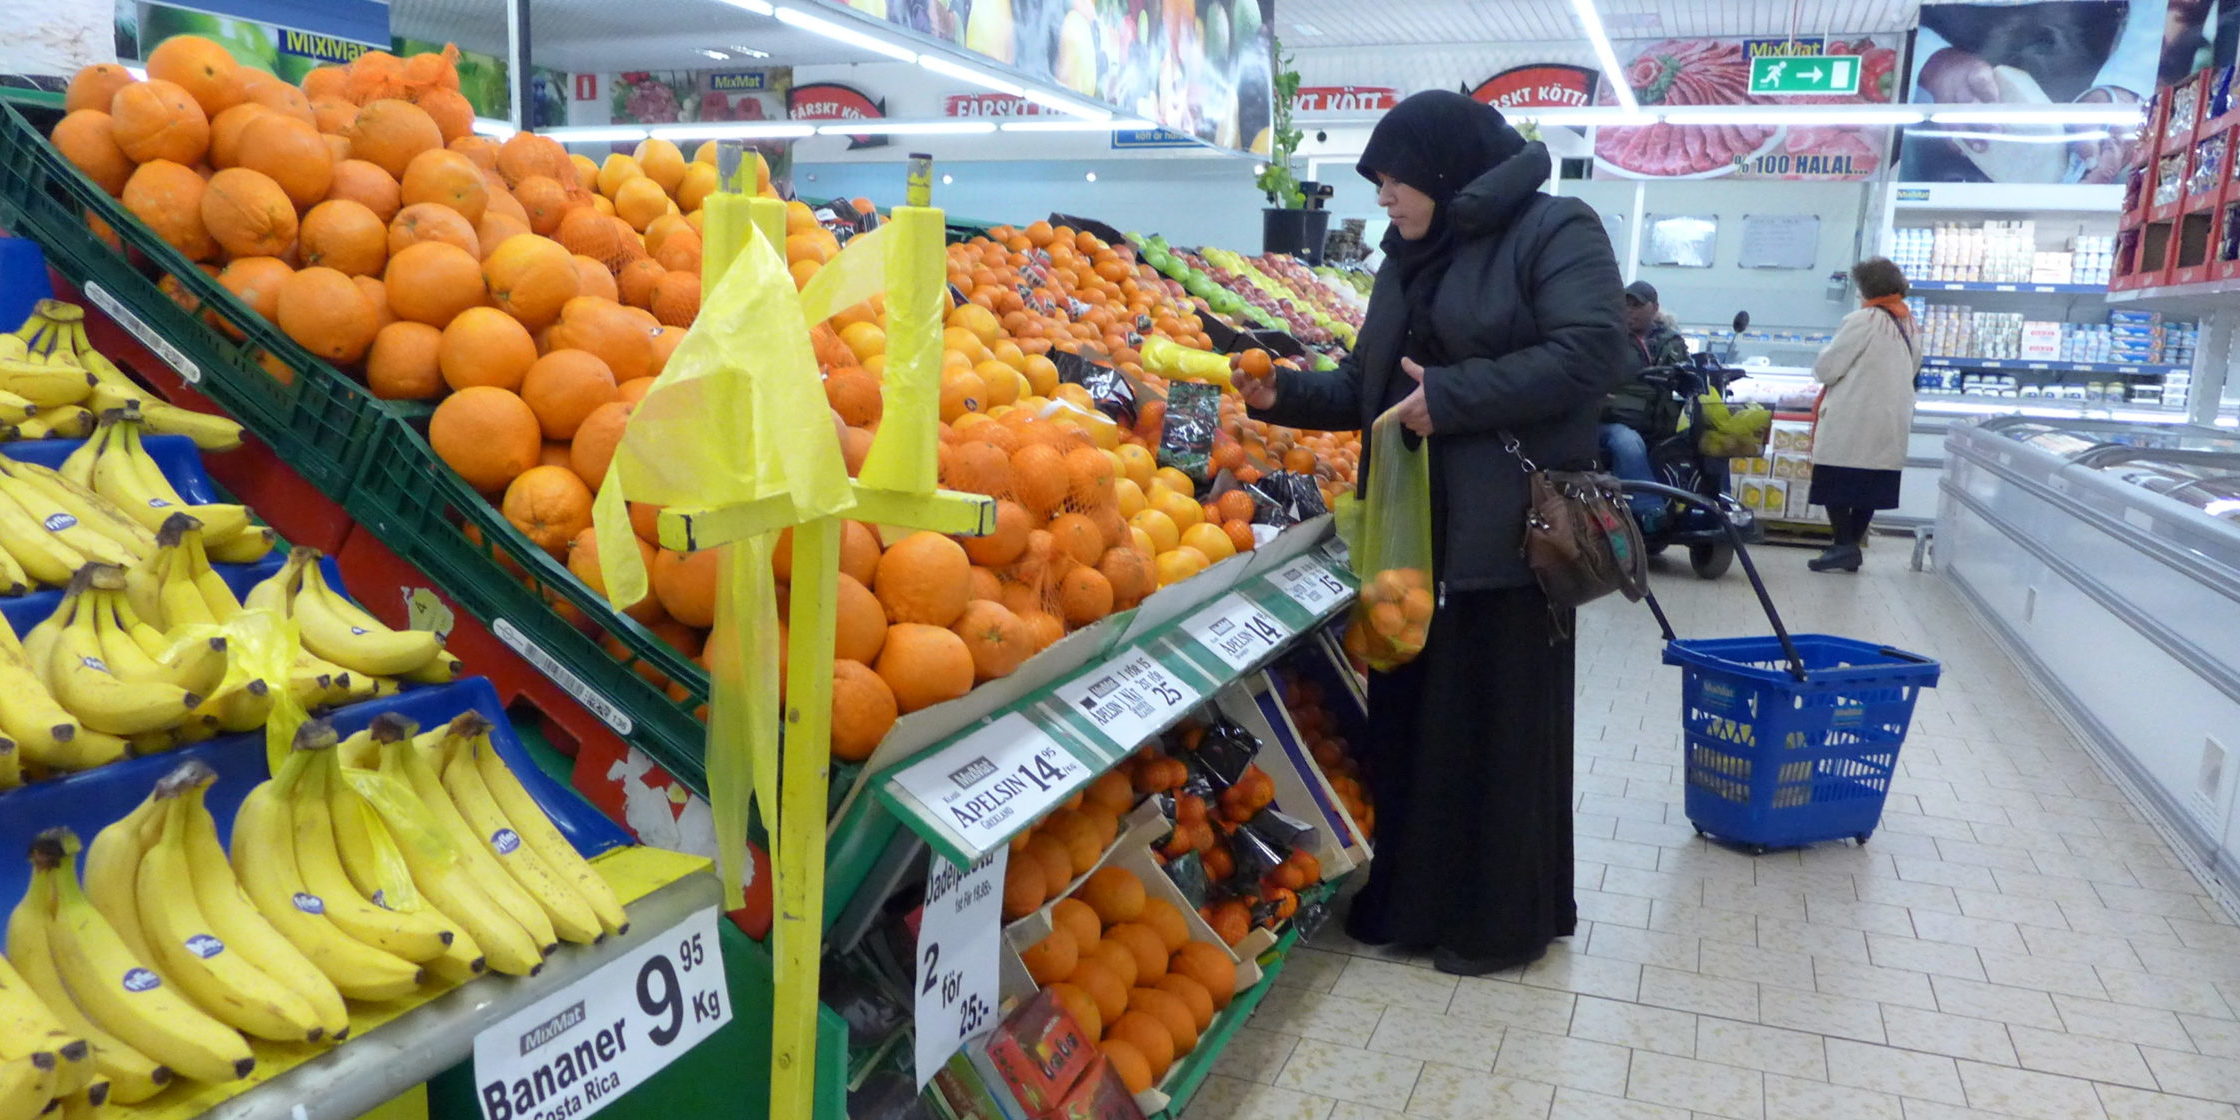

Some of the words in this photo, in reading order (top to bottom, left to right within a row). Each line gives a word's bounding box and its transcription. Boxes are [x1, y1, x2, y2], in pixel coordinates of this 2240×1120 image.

[1750, 41, 1821, 56] MixMat
[715, 74, 760, 88] MixMat
[1756, 154, 1790, 175] 100
[1319, 575, 1344, 595] 15
[1244, 615, 1283, 646] 14
[1152, 681, 1183, 706] 25
[1040, 746, 1057, 760] 95
[1017, 754, 1067, 793] 14
[949, 773, 1029, 829] APELSIN
[922, 942, 939, 997] 2
[942, 969, 963, 1009] för
[692, 990, 721, 1024] Kg
[959, 992, 990, 1040] 25:-
[482, 1017, 628, 1120] Bananer
[635, 954, 685, 1047] 9
[679, 932, 705, 972] 95
[523, 1004, 584, 1053] MixMat
[584, 1071, 621, 1105] Rica
